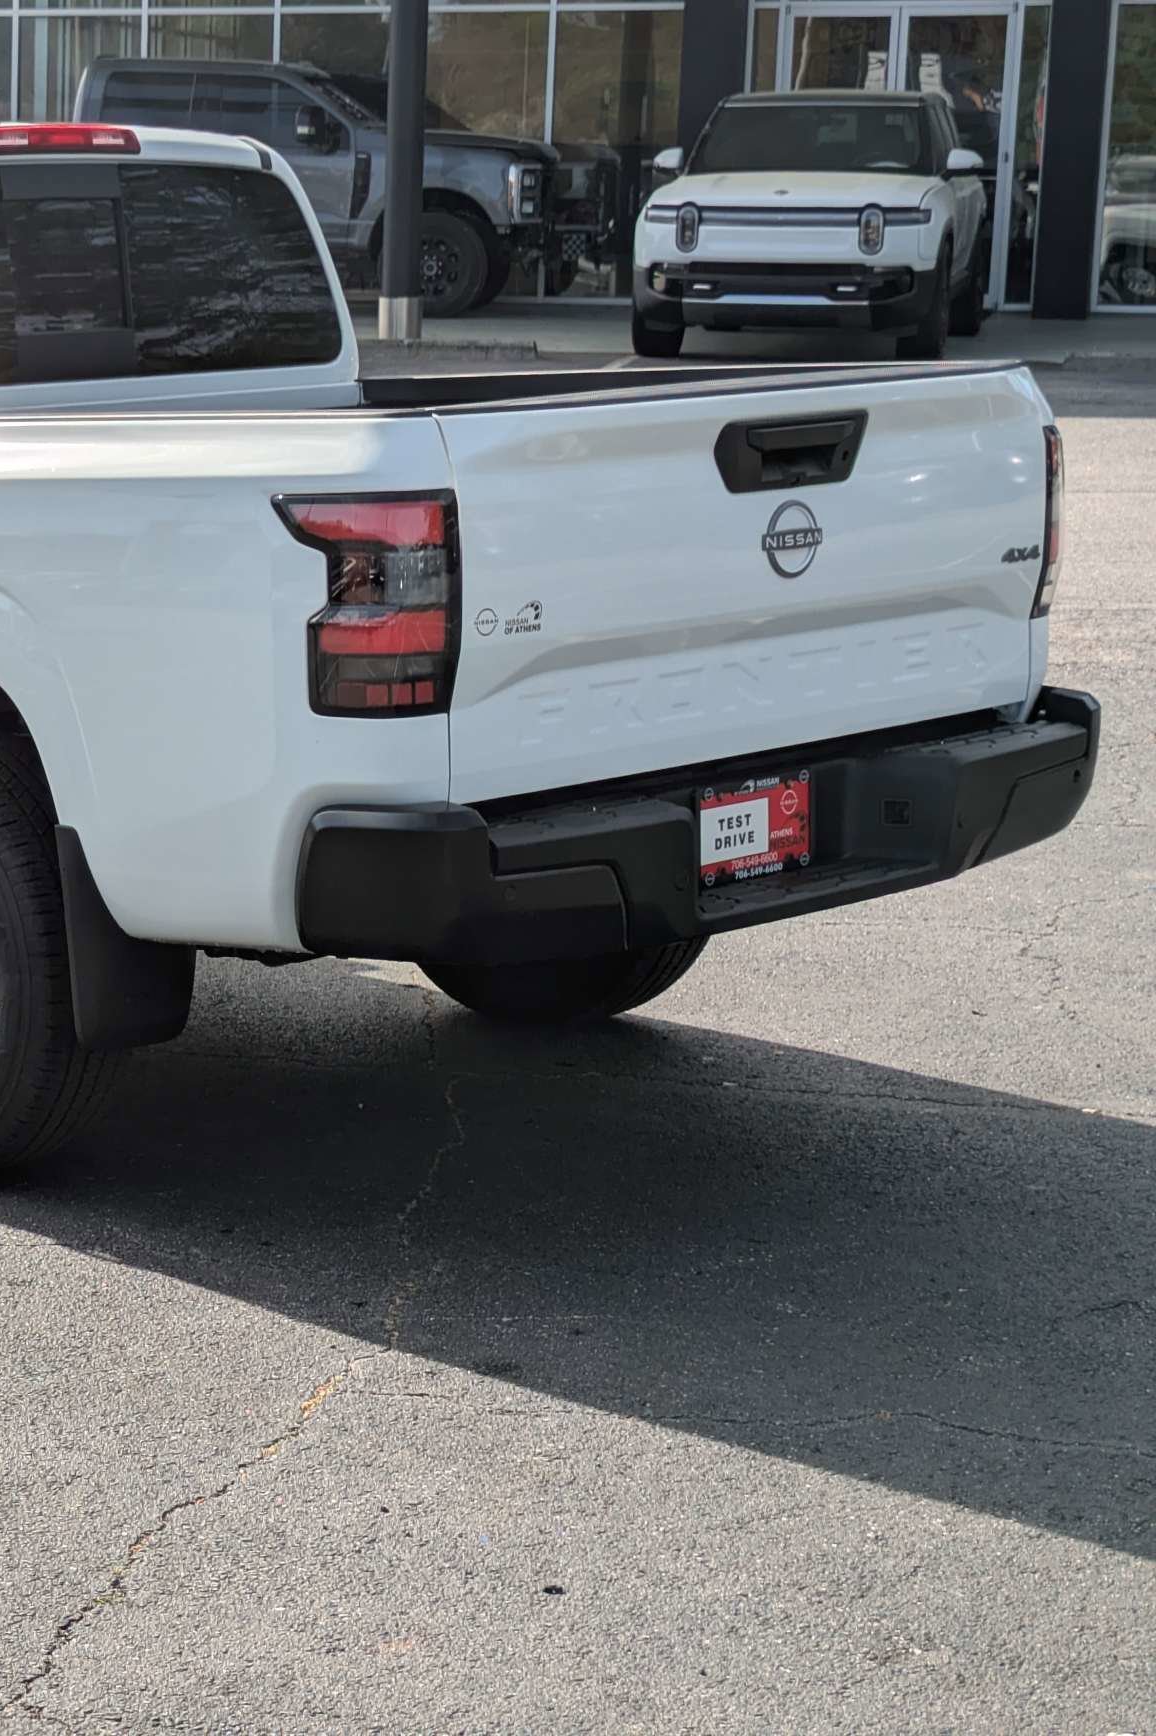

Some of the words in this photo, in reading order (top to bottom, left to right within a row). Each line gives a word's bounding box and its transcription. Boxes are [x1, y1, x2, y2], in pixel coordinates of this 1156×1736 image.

[765, 531, 821, 549] NISSAN
[504, 627, 514, 635] OF
[515, 623, 541, 634] ATHENS
[505, 618, 529, 627] NISSAN
[756, 776, 780, 787] NISSAN
[717, 813, 752, 832] TEST
[714, 831, 755, 850] DRIVE
[769, 827, 794, 840] ATHENS
[734, 862, 784, 881] 706-549-6600
